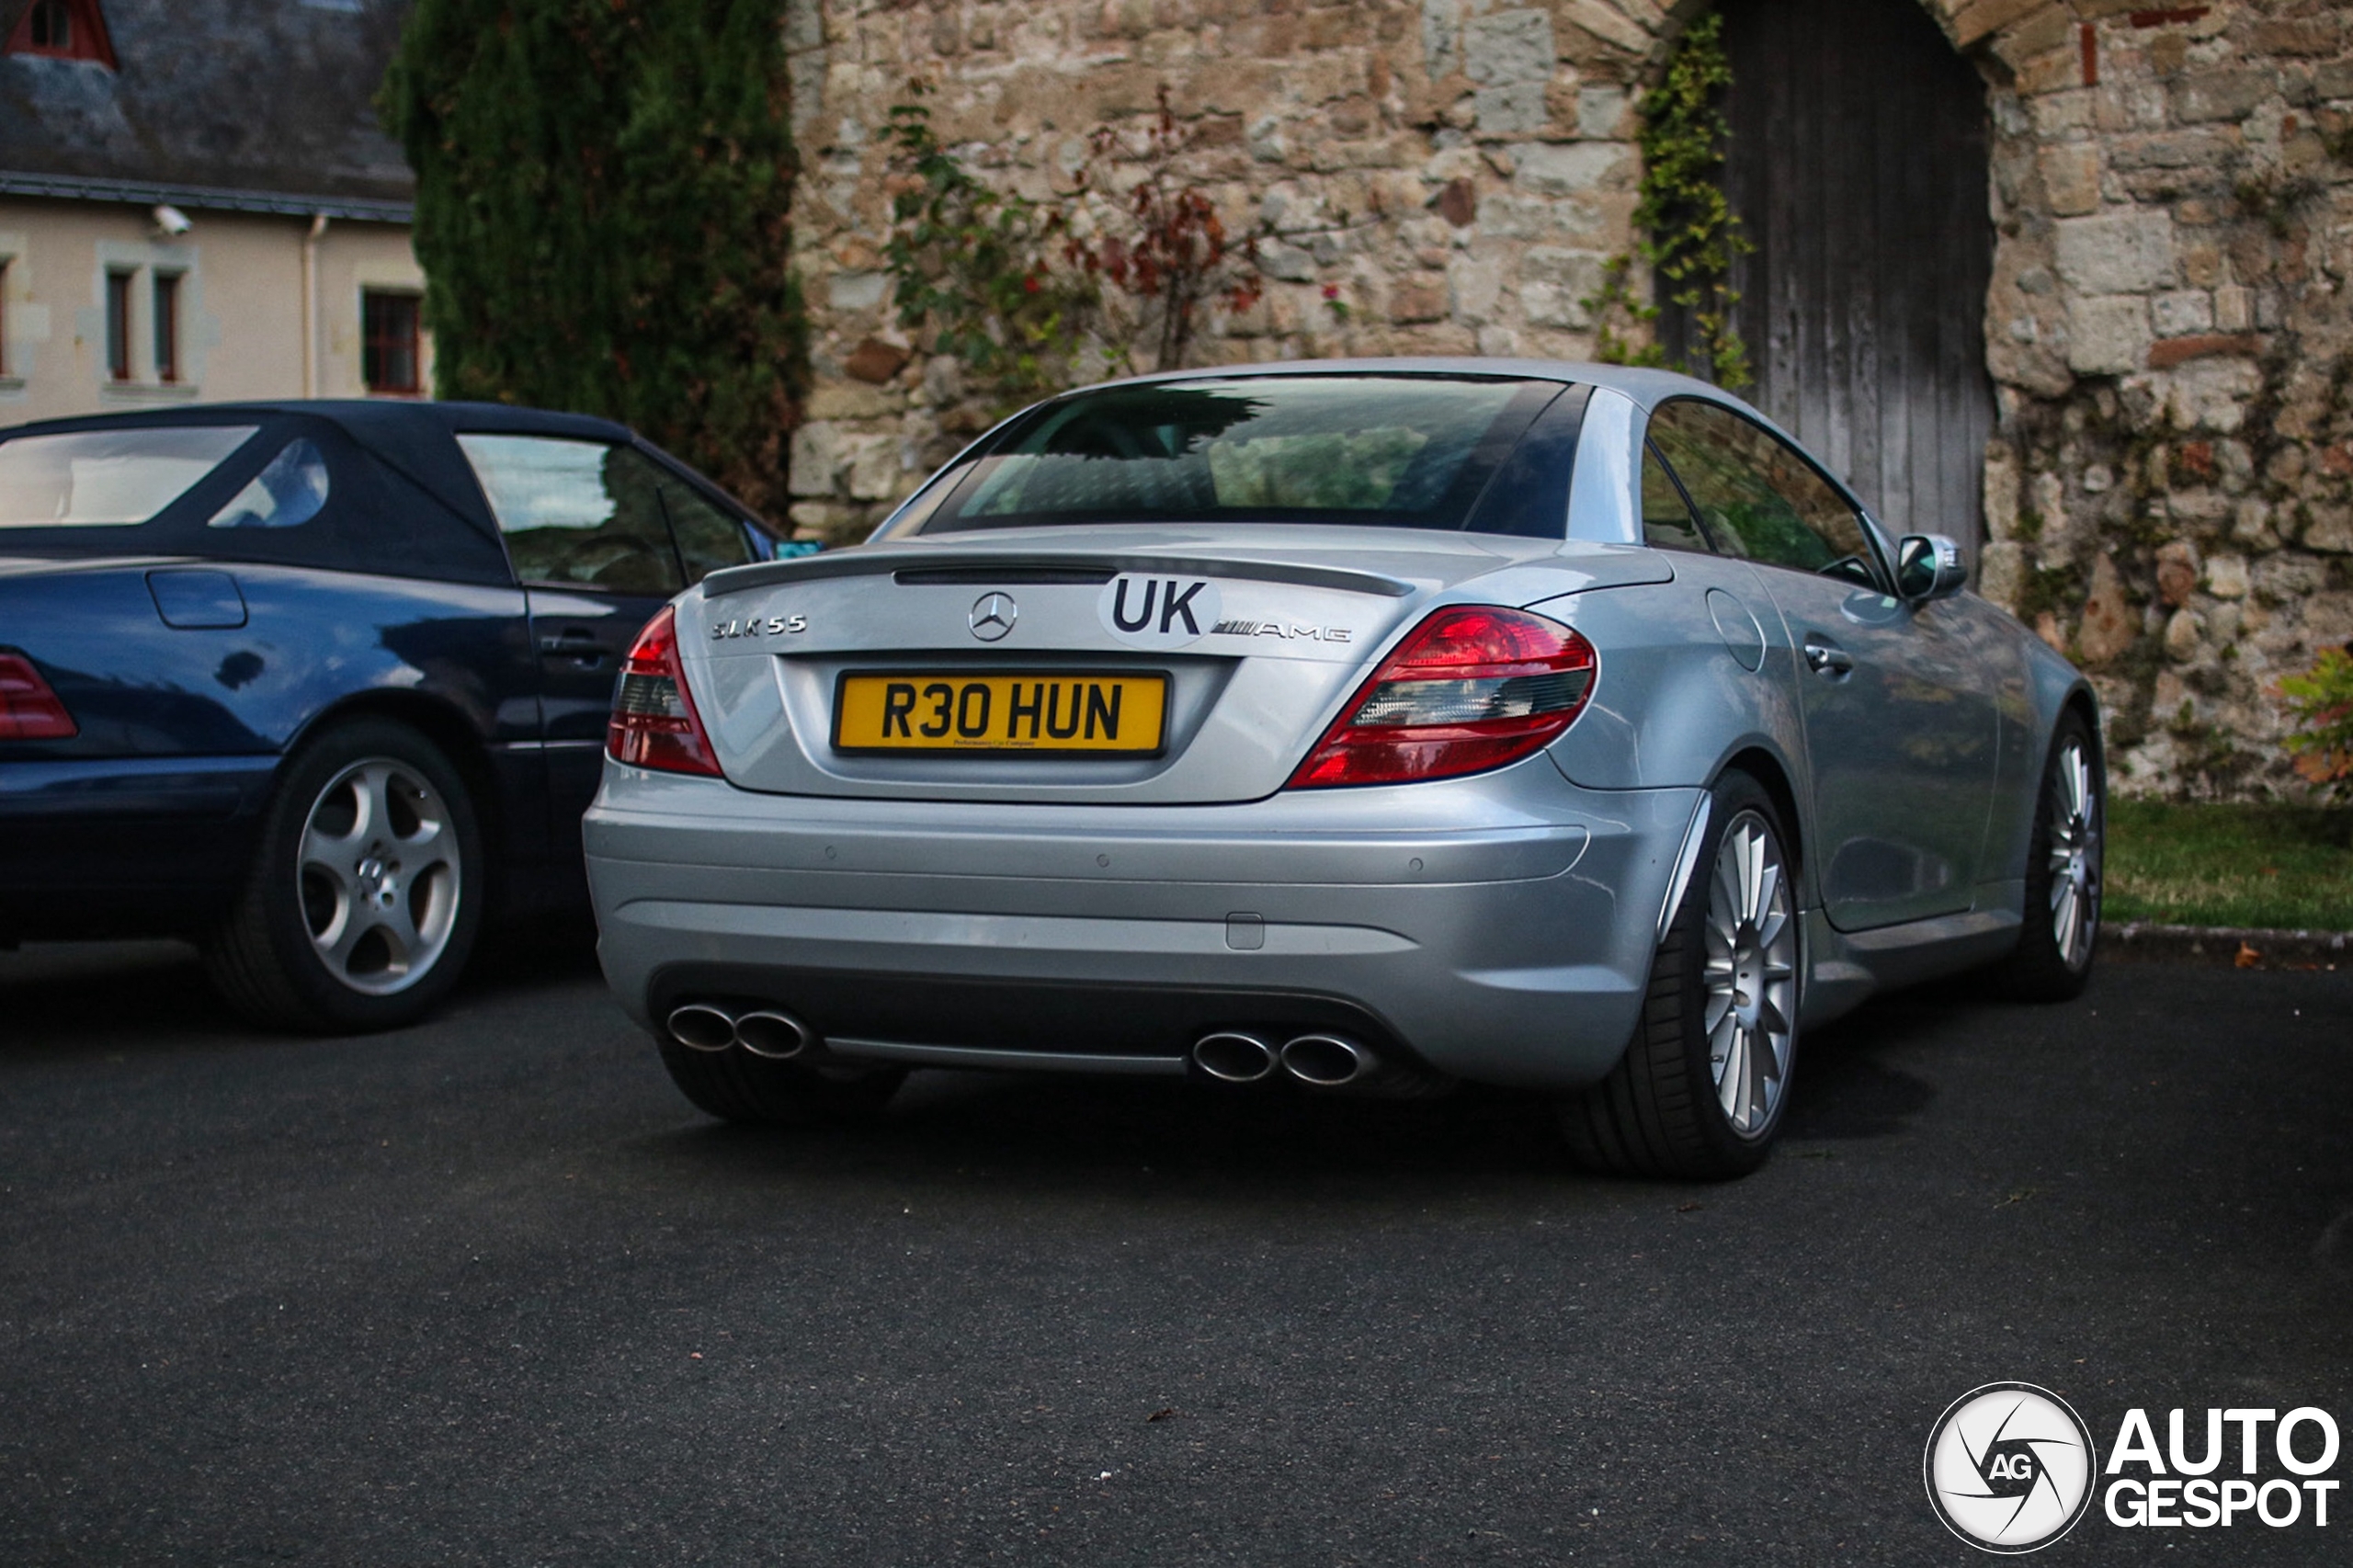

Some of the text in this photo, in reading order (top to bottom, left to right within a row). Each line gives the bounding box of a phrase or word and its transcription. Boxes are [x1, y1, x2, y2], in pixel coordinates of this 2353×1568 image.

[1113, 578, 1207, 635] UK
[710, 615, 808, 641] SLK 55
[1253, 621, 1353, 643] AMG
[881, 683, 1123, 741] R30 HUN
[1006, 739, 1036, 749] Company
